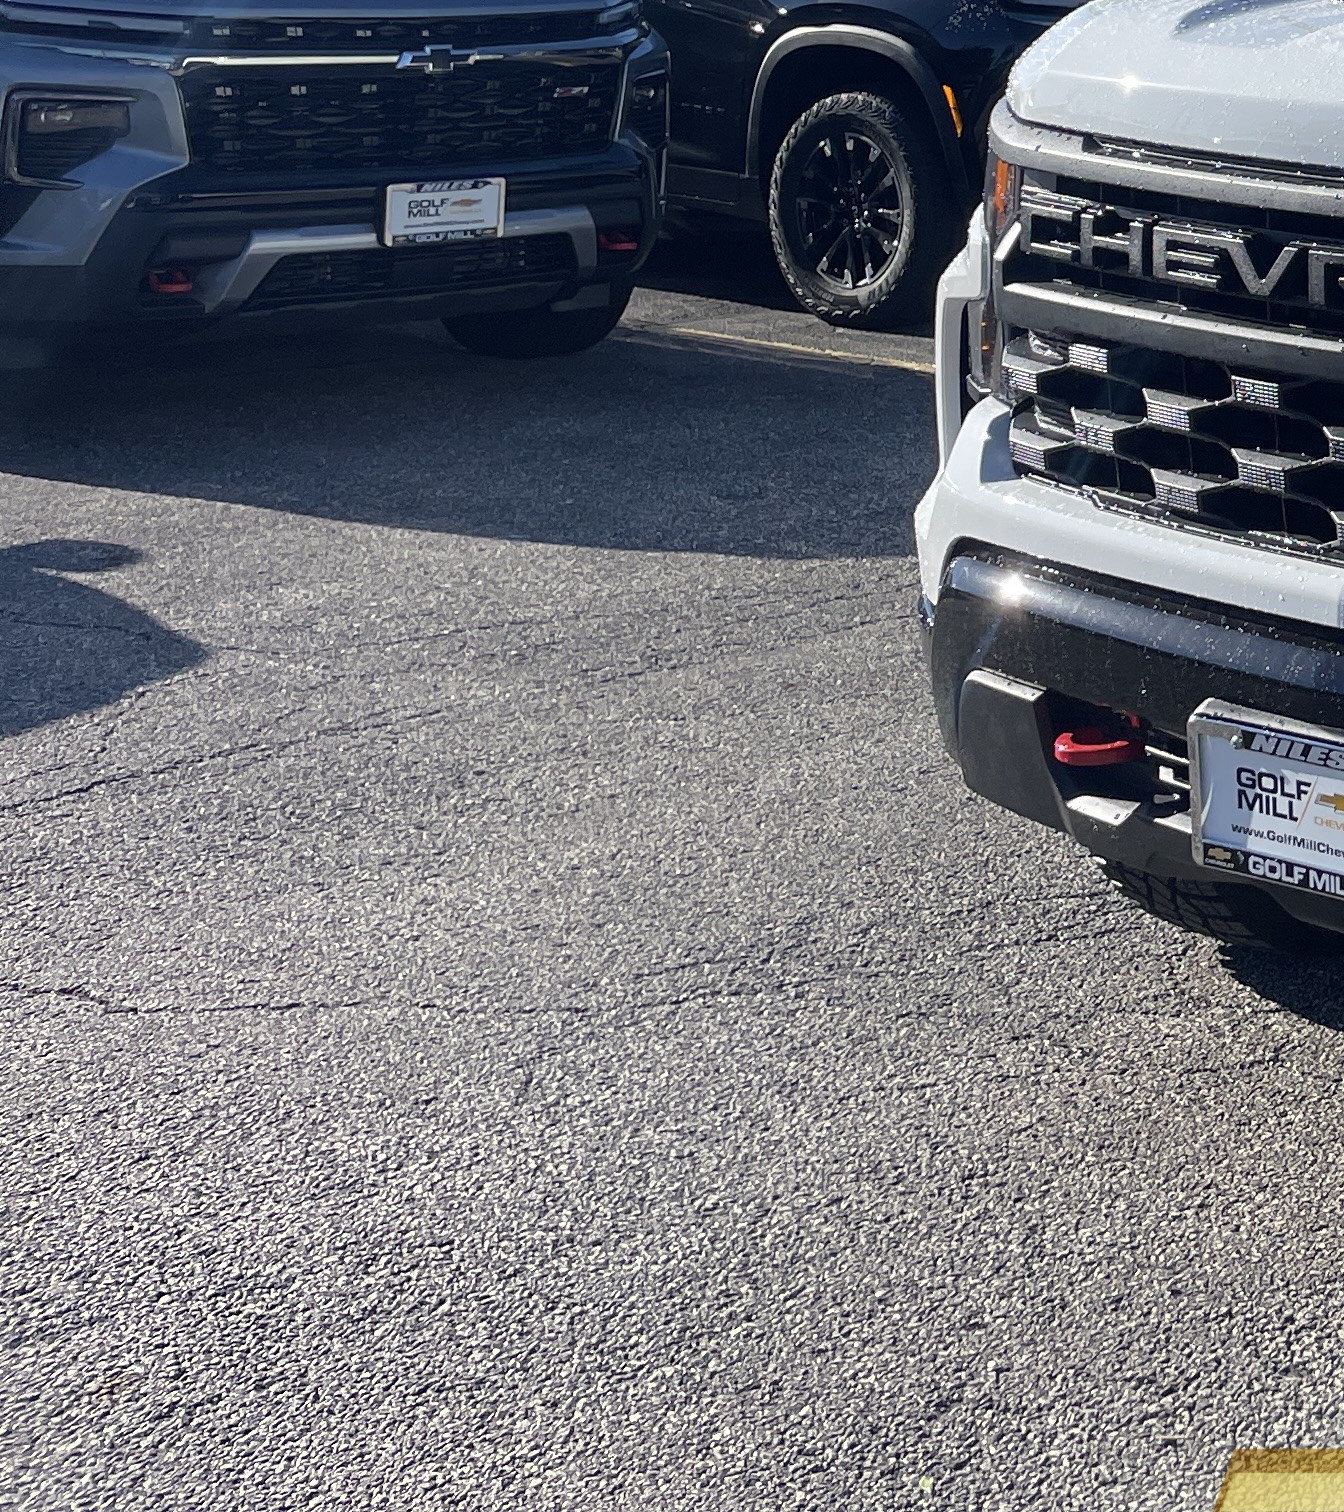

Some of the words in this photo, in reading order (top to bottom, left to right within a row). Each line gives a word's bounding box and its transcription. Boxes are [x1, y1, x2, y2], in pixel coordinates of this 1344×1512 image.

[408, 198, 449, 209] GOLF
[408, 208, 441, 219] MILL
[1236, 766, 1312, 801] GOLF
[1238, 789, 1299, 823] MILL
[1248, 855, 1308, 885] GOLF
